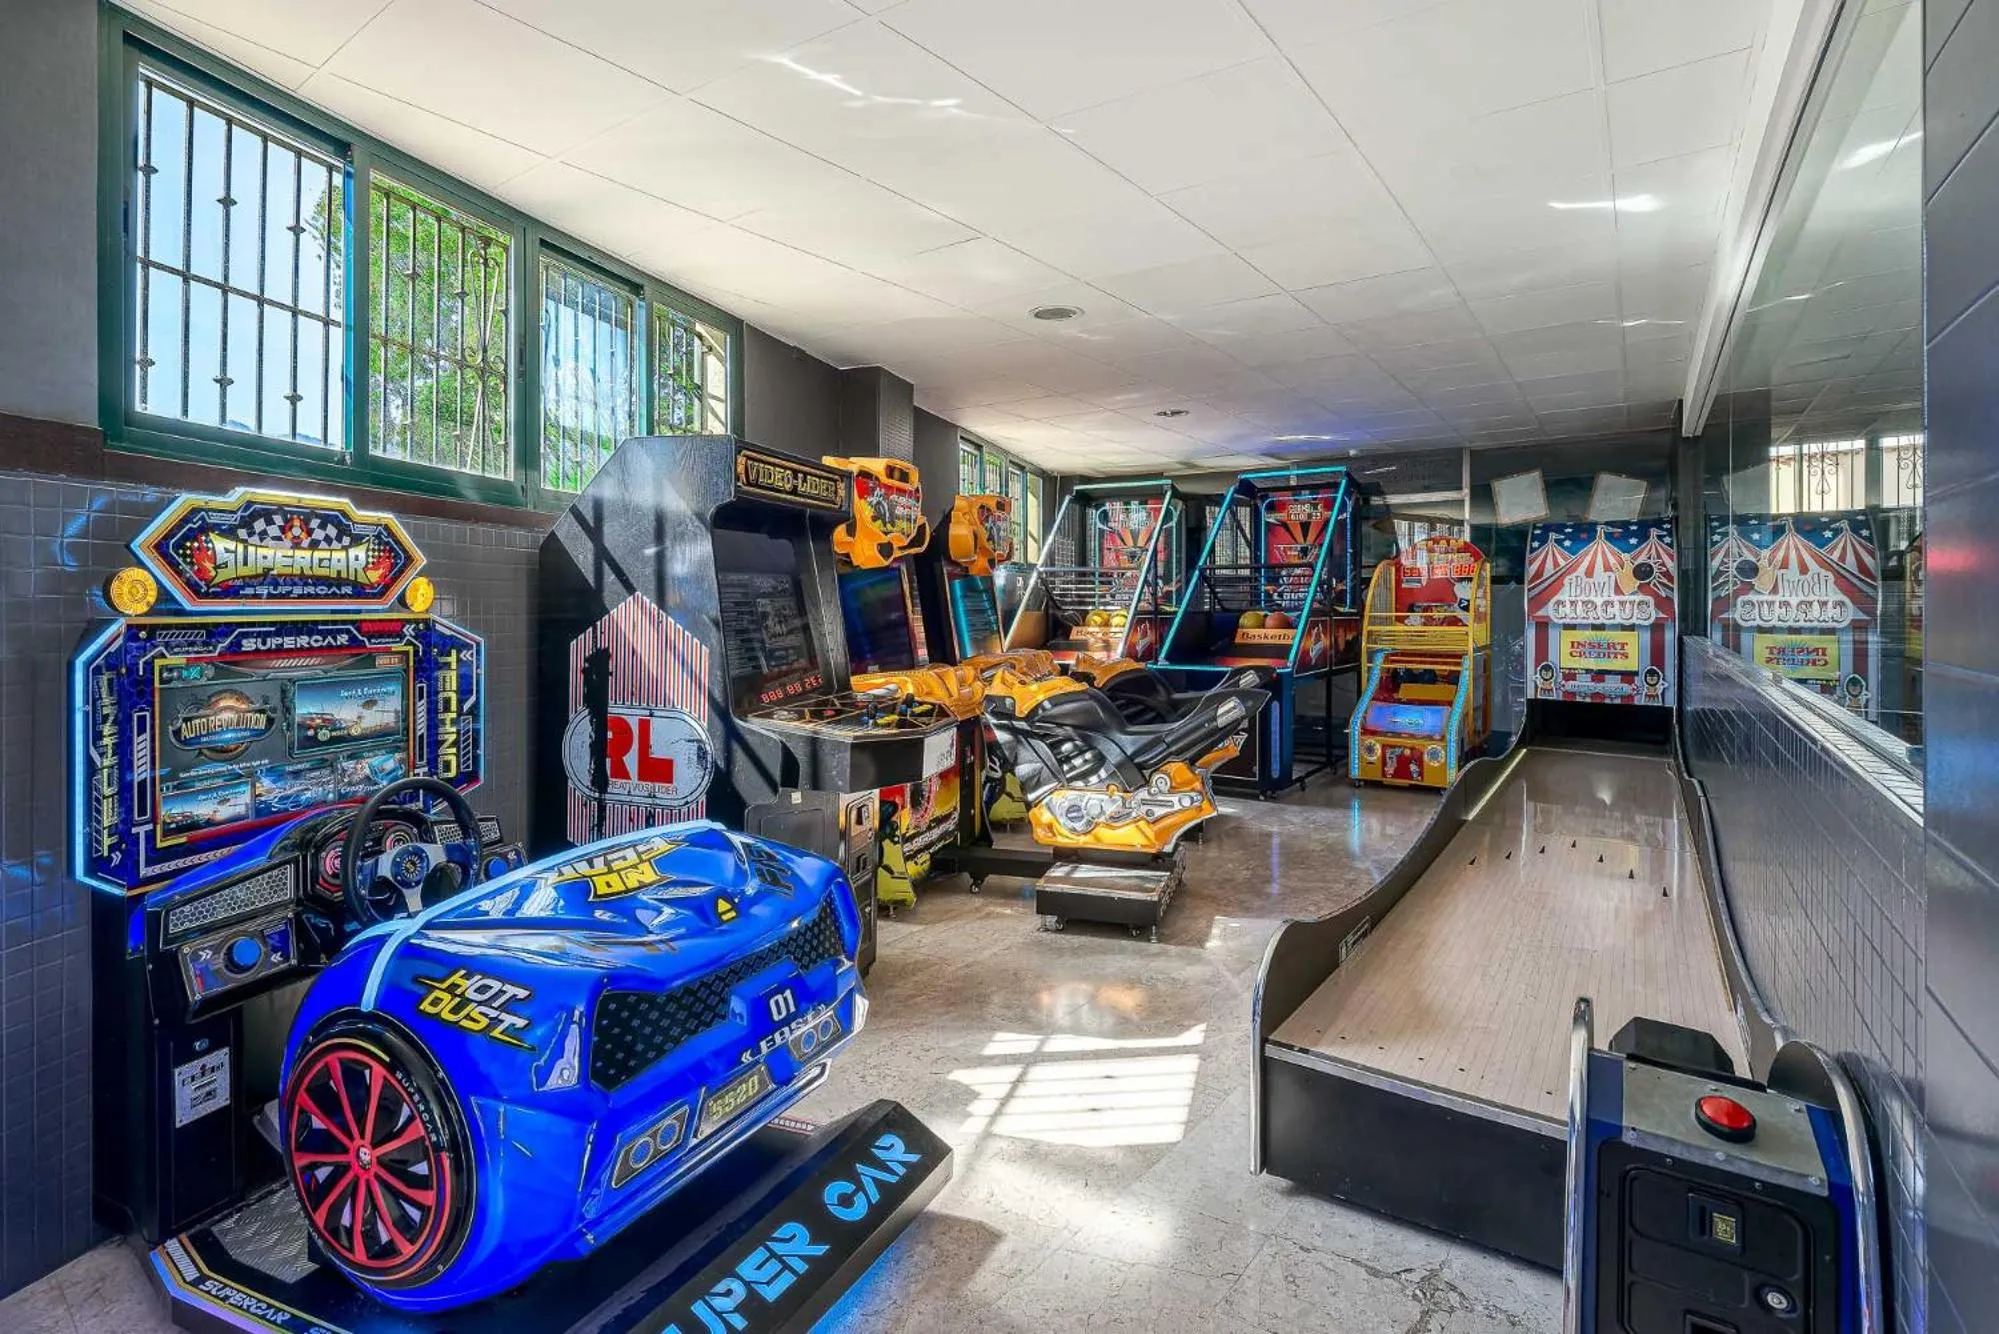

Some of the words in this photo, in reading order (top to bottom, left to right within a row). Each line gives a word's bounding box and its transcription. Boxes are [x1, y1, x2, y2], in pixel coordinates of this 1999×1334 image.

[748, 460, 837, 498] VIDEO-LIDER
[209, 532, 372, 585] SUPERCAR
[255, 585, 353, 595] SUPERCAR
[1552, 598, 1652, 621] CIRCUS
[241, 634, 350, 650] SUPERCAR
[1569, 640, 1629, 651] INSERT
[1569, 651, 1629, 660] CREDITS
[438, 649, 457, 778] TECHNO
[418, 969, 532, 1008] HOT
[769, 989, 797, 1022] 01
[419, 990, 533, 1047] DUST
[661, 1221, 832, 1334] UPER
[824, 1133, 922, 1222] CAR
[198, 1279, 292, 1324] SUPERCAR
